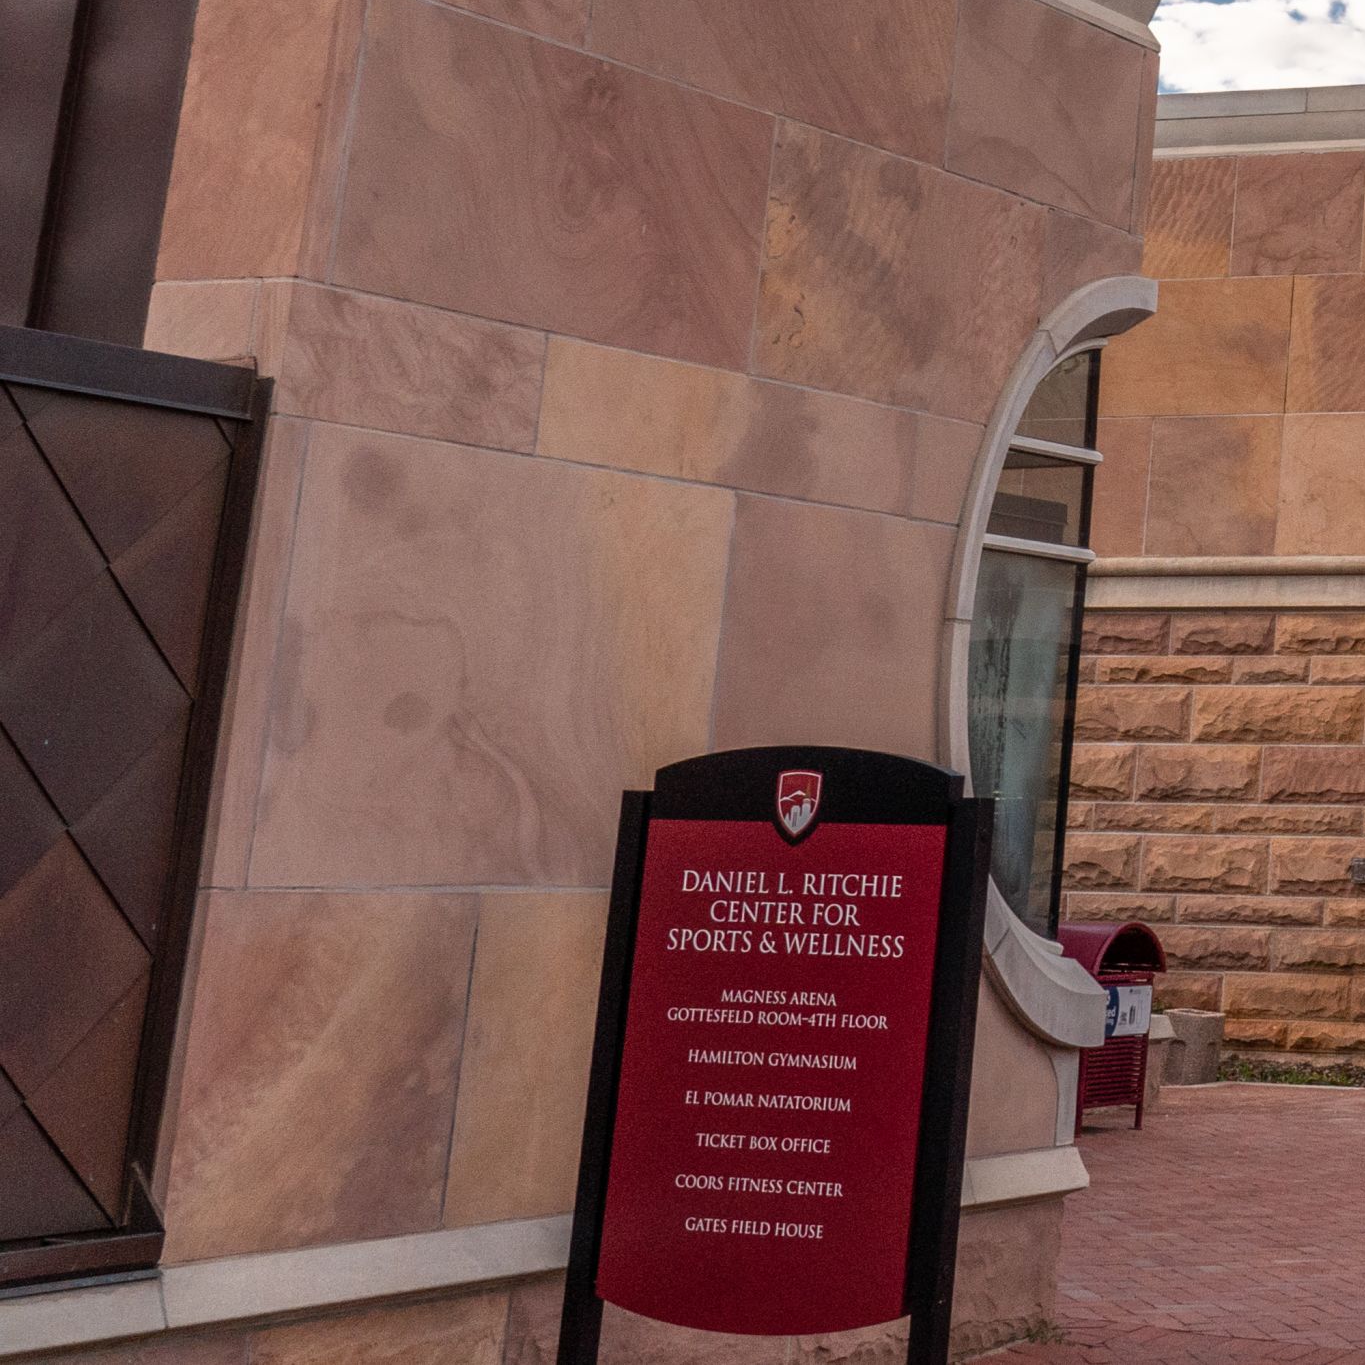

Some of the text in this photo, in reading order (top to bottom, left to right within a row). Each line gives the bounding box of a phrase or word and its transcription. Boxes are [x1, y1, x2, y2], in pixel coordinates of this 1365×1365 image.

[682, 870, 903, 898] DANIEL L. RITCHIE
[710, 900, 860, 927] CENTER FOR
[667, 928, 905, 958] SPORTS & WELLNESS
[721, 989, 837, 1007] MAGNESS ARENA
[667, 1007, 754, 1024] GOTTESFELD
[841, 1014, 889, 1030] FLOOR
[688, 1049, 857, 1070] HAMILTON GYMNASIUM
[685, 1091, 851, 1113] EL POMAR NATATORIUM
[696, 1133, 831, 1154] TICKET BOX OFFICE
[675, 1174, 844, 1197] COORS FITNESS CENTER
[685, 1216, 824, 1239] GATES FIELD HOUSE
